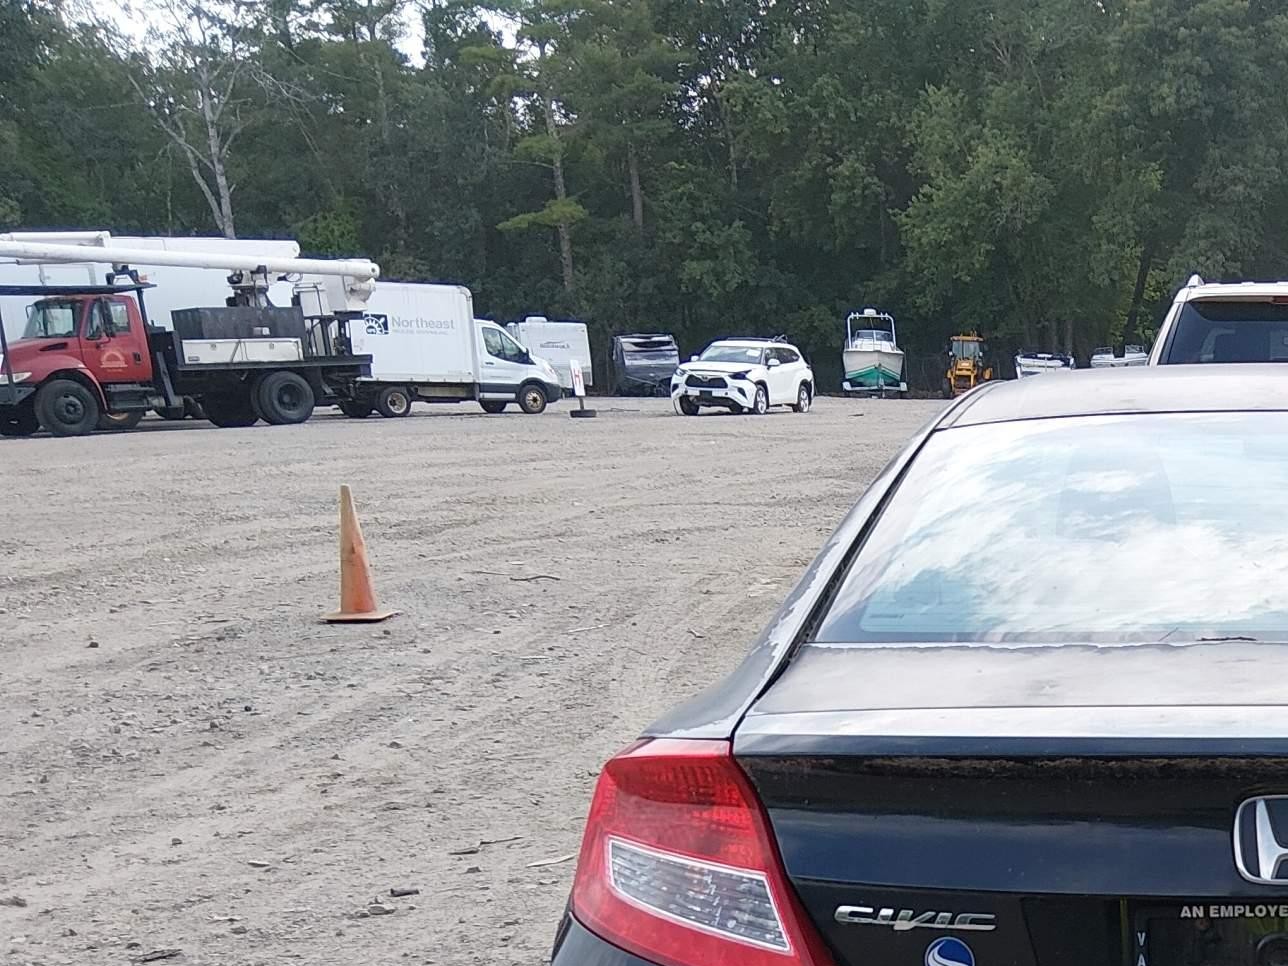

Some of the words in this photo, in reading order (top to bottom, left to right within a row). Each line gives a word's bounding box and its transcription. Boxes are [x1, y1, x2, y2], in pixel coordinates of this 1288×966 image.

[391, 316, 456, 330] Northeast
[834, 905, 997, 931] CIVIC
[1180, 905, 1204, 918] AN
